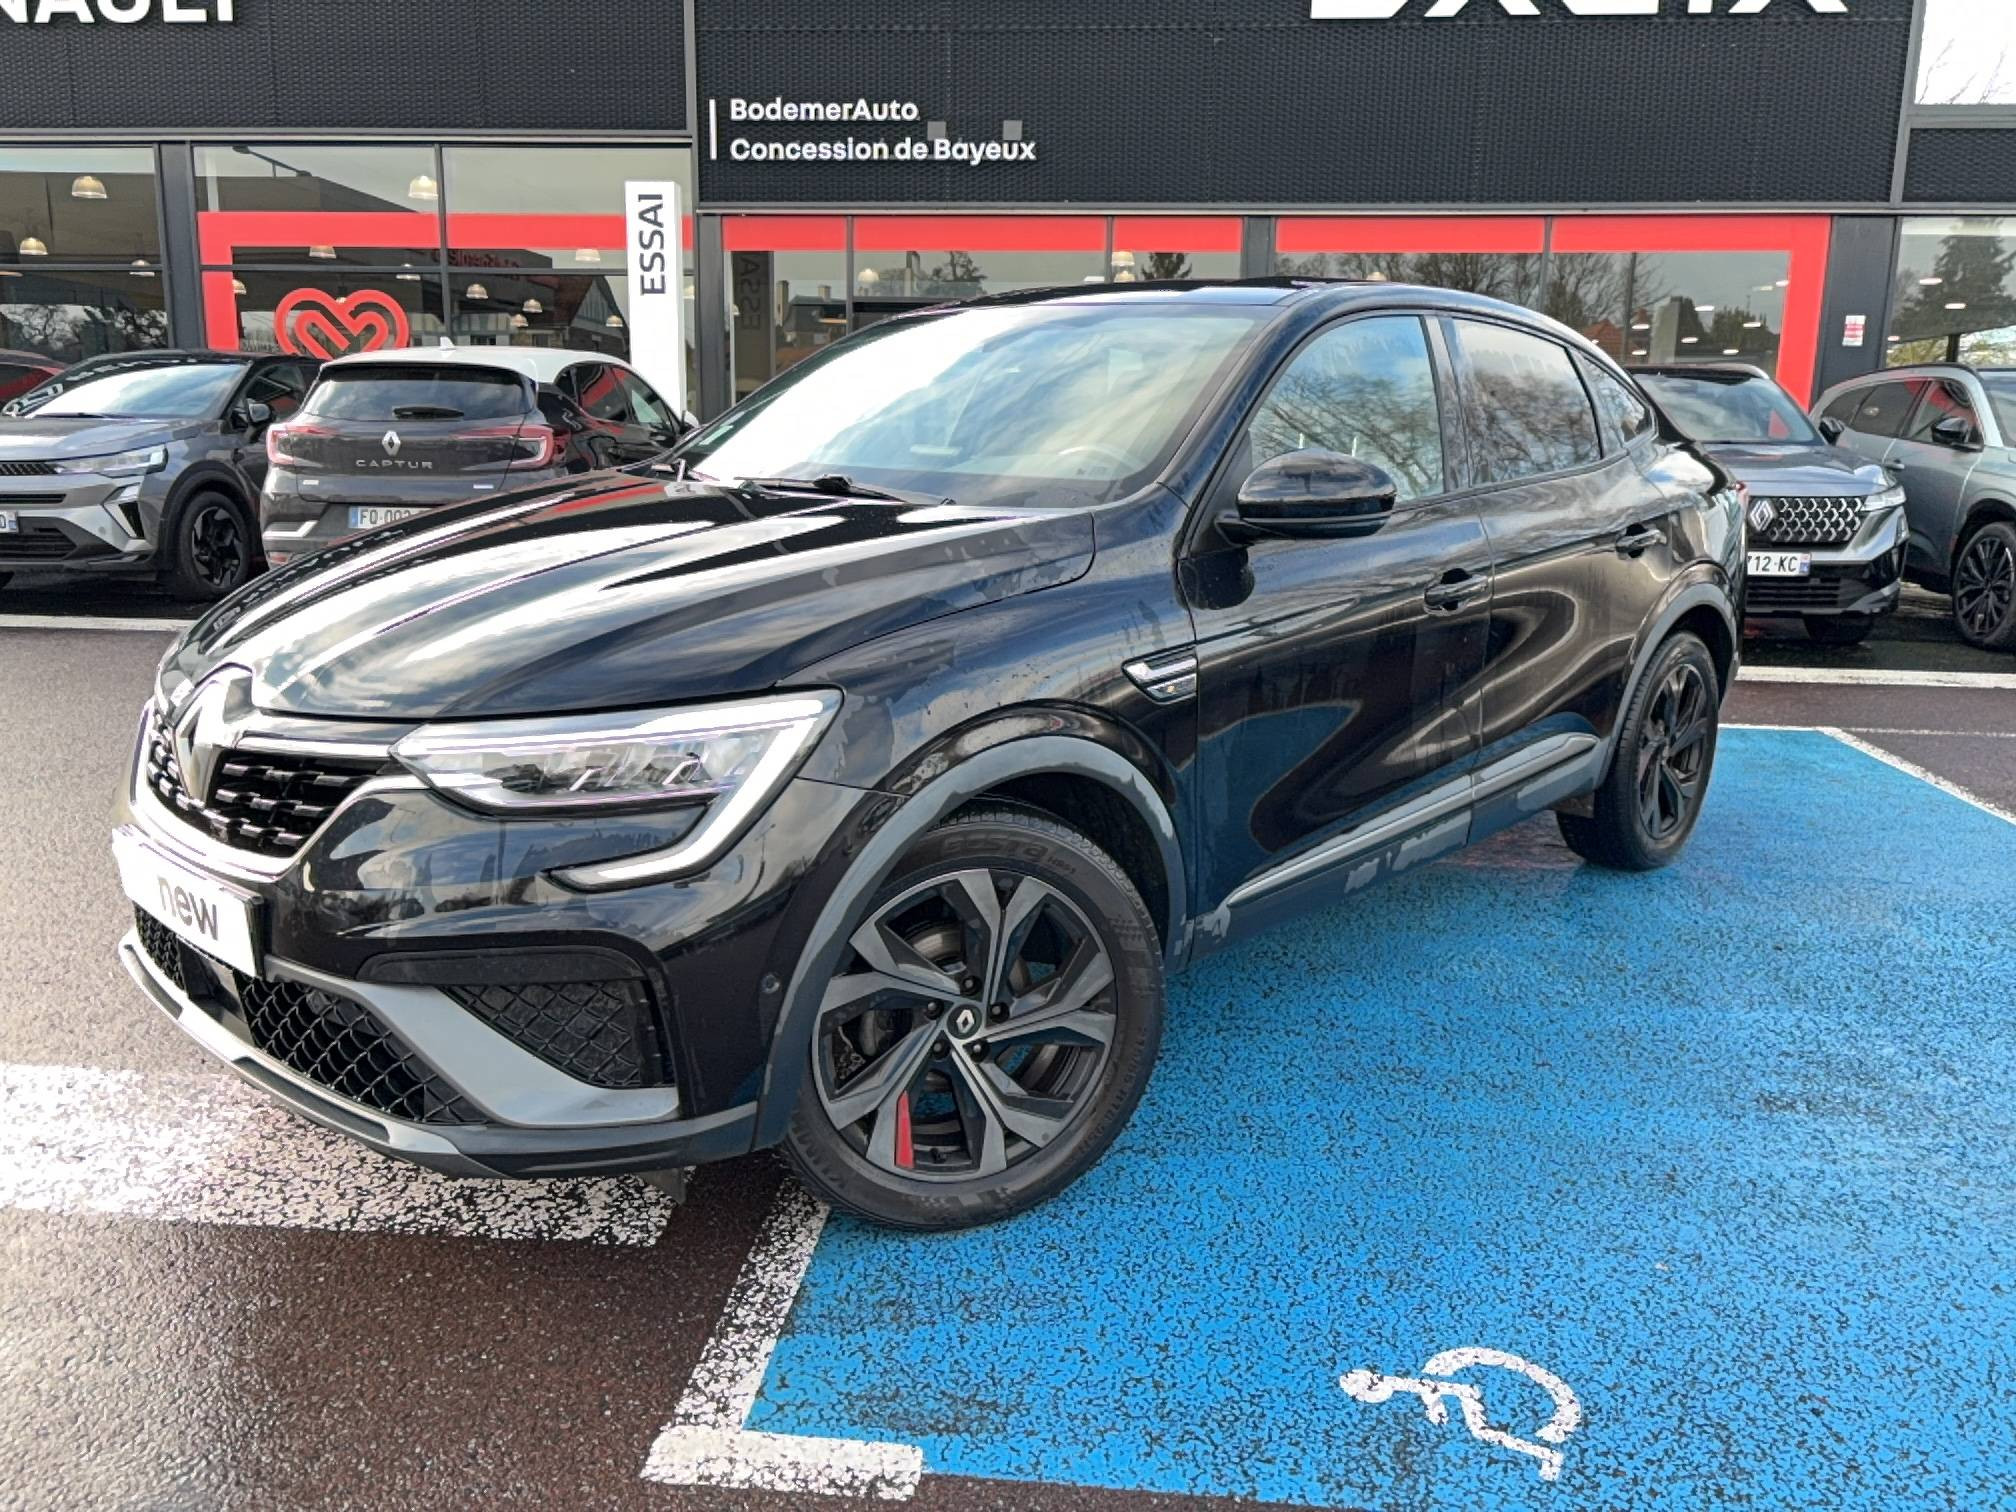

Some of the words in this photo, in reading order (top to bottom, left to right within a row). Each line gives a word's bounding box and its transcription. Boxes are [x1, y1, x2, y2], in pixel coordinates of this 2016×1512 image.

[729, 98, 919, 122] BodemerAuto
[729, 138, 890, 161] Concession
[896, 137, 928, 161] de
[932, 138, 1037, 166] Bayeux
[637, 193, 666, 296] ESSAI
[355, 459, 433, 470] CAPTUR
[157, 876, 218, 940] new
